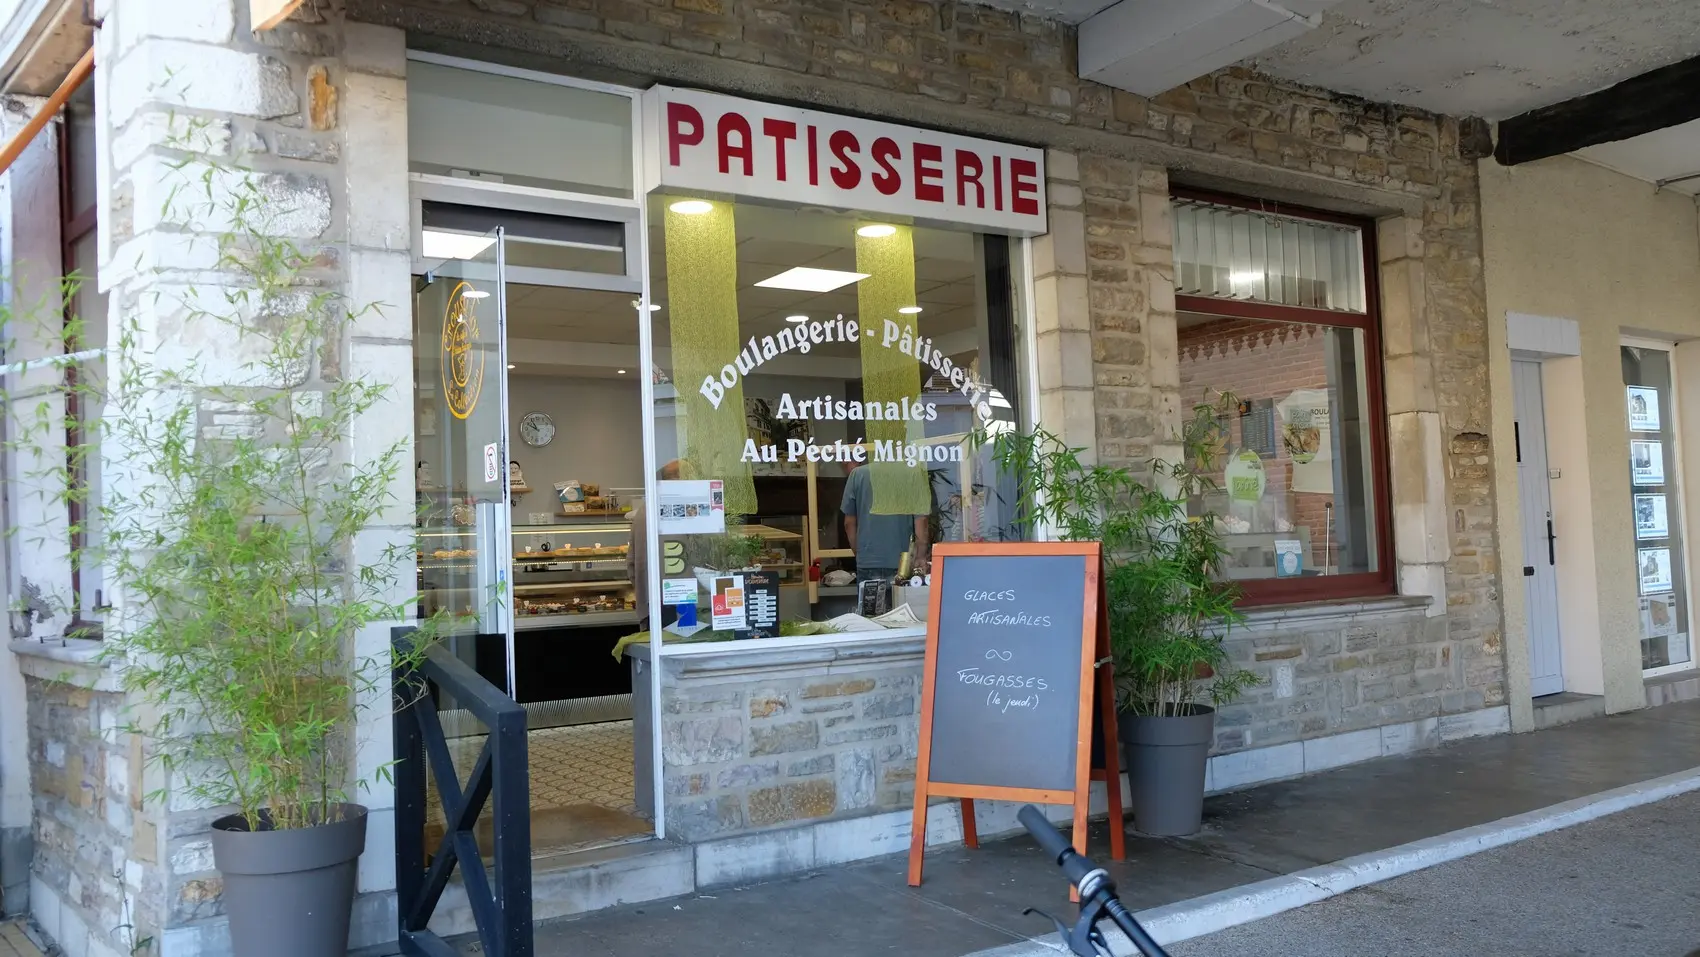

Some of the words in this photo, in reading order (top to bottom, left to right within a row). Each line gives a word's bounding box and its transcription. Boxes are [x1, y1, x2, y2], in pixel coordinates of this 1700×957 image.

[667, 102, 1039, 216] PATISSERIE
[700, 313, 859, 411] Boulangerie
[883, 318, 993, 423] Pâtisserie
[776, 393, 938, 422] Artisanales
[740, 438, 778, 463] Au
[787, 436, 866, 463] Péché
[874, 439, 964, 468] Mignon
[964, 589, 1016, 602] GLACES
